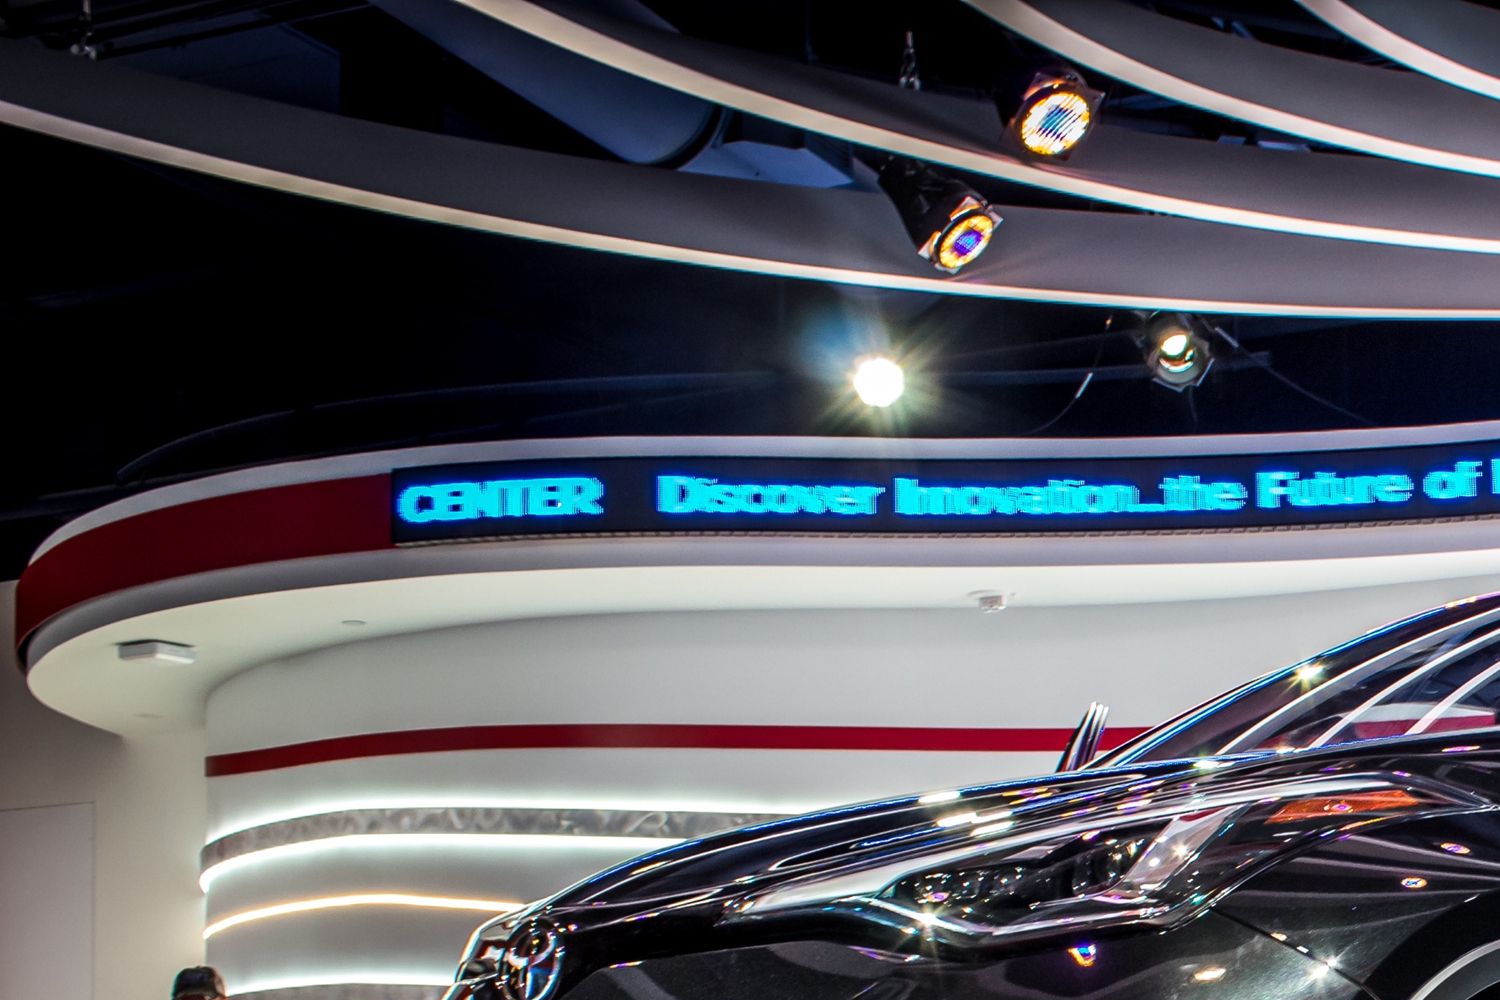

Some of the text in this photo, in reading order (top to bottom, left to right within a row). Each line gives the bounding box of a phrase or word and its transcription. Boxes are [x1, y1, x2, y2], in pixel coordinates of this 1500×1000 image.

[398, 477, 604, 522] CENTER
[657, 475, 886, 514] Discover
[1255, 471, 1414, 508] Future
[1423, 461, 1482, 499] of
